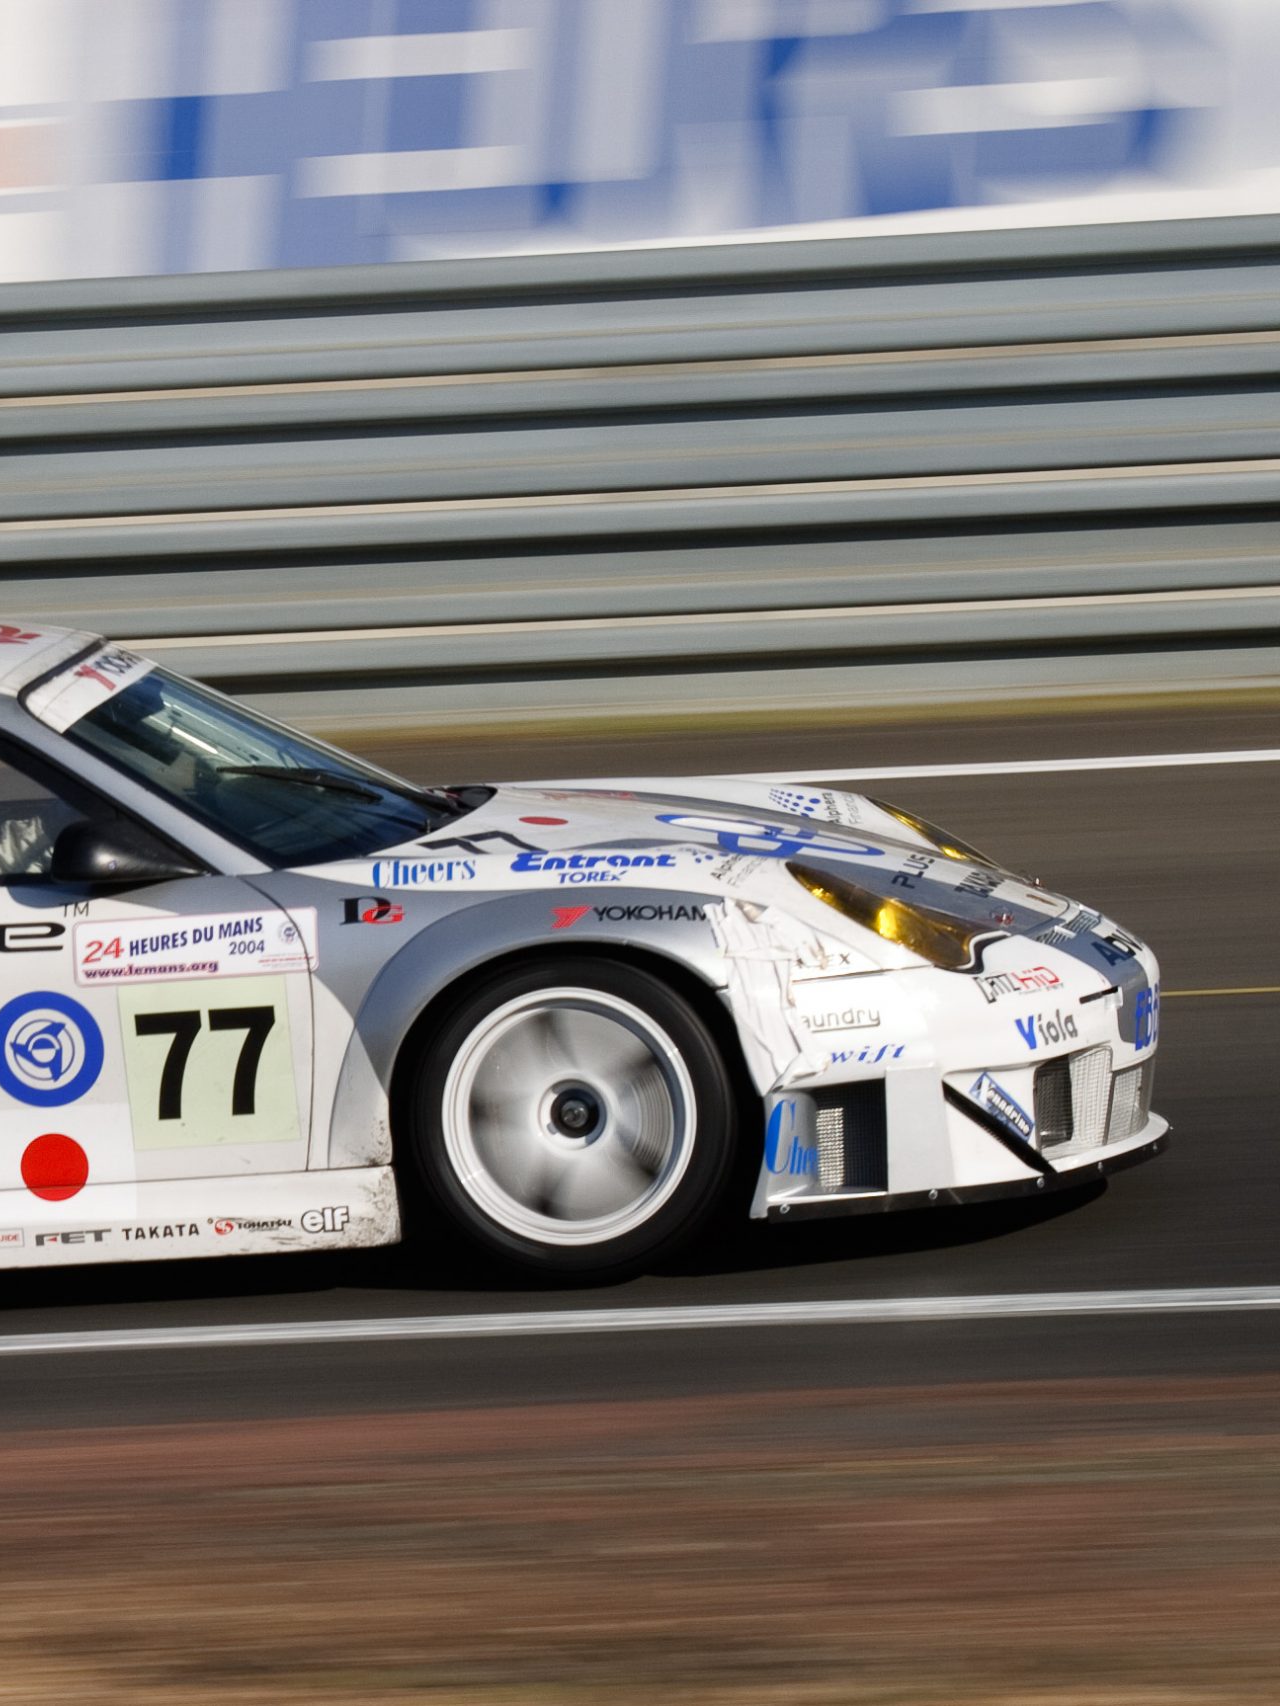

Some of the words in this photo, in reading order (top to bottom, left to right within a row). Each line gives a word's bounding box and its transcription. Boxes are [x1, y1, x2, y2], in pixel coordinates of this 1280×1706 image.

[372, 858, 476, 889] Cheers
[82, 938, 124, 965] 24
[129, 931, 188, 957] HEURES
[192, 926, 214, 945] DU
[218, 917, 263, 940] MANS
[229, 940, 265, 956] 2004
[84, 961, 219, 980] www.lemans.org
[800, 1007, 881, 1030] aundry
[1014, 1008, 1079, 1050] Viola
[134, 1005, 276, 1120] 77
[831, 1043, 906, 1064] wift
[122, 1223, 200, 1241] TAKATA
[301, 1206, 349, 1234] elf
